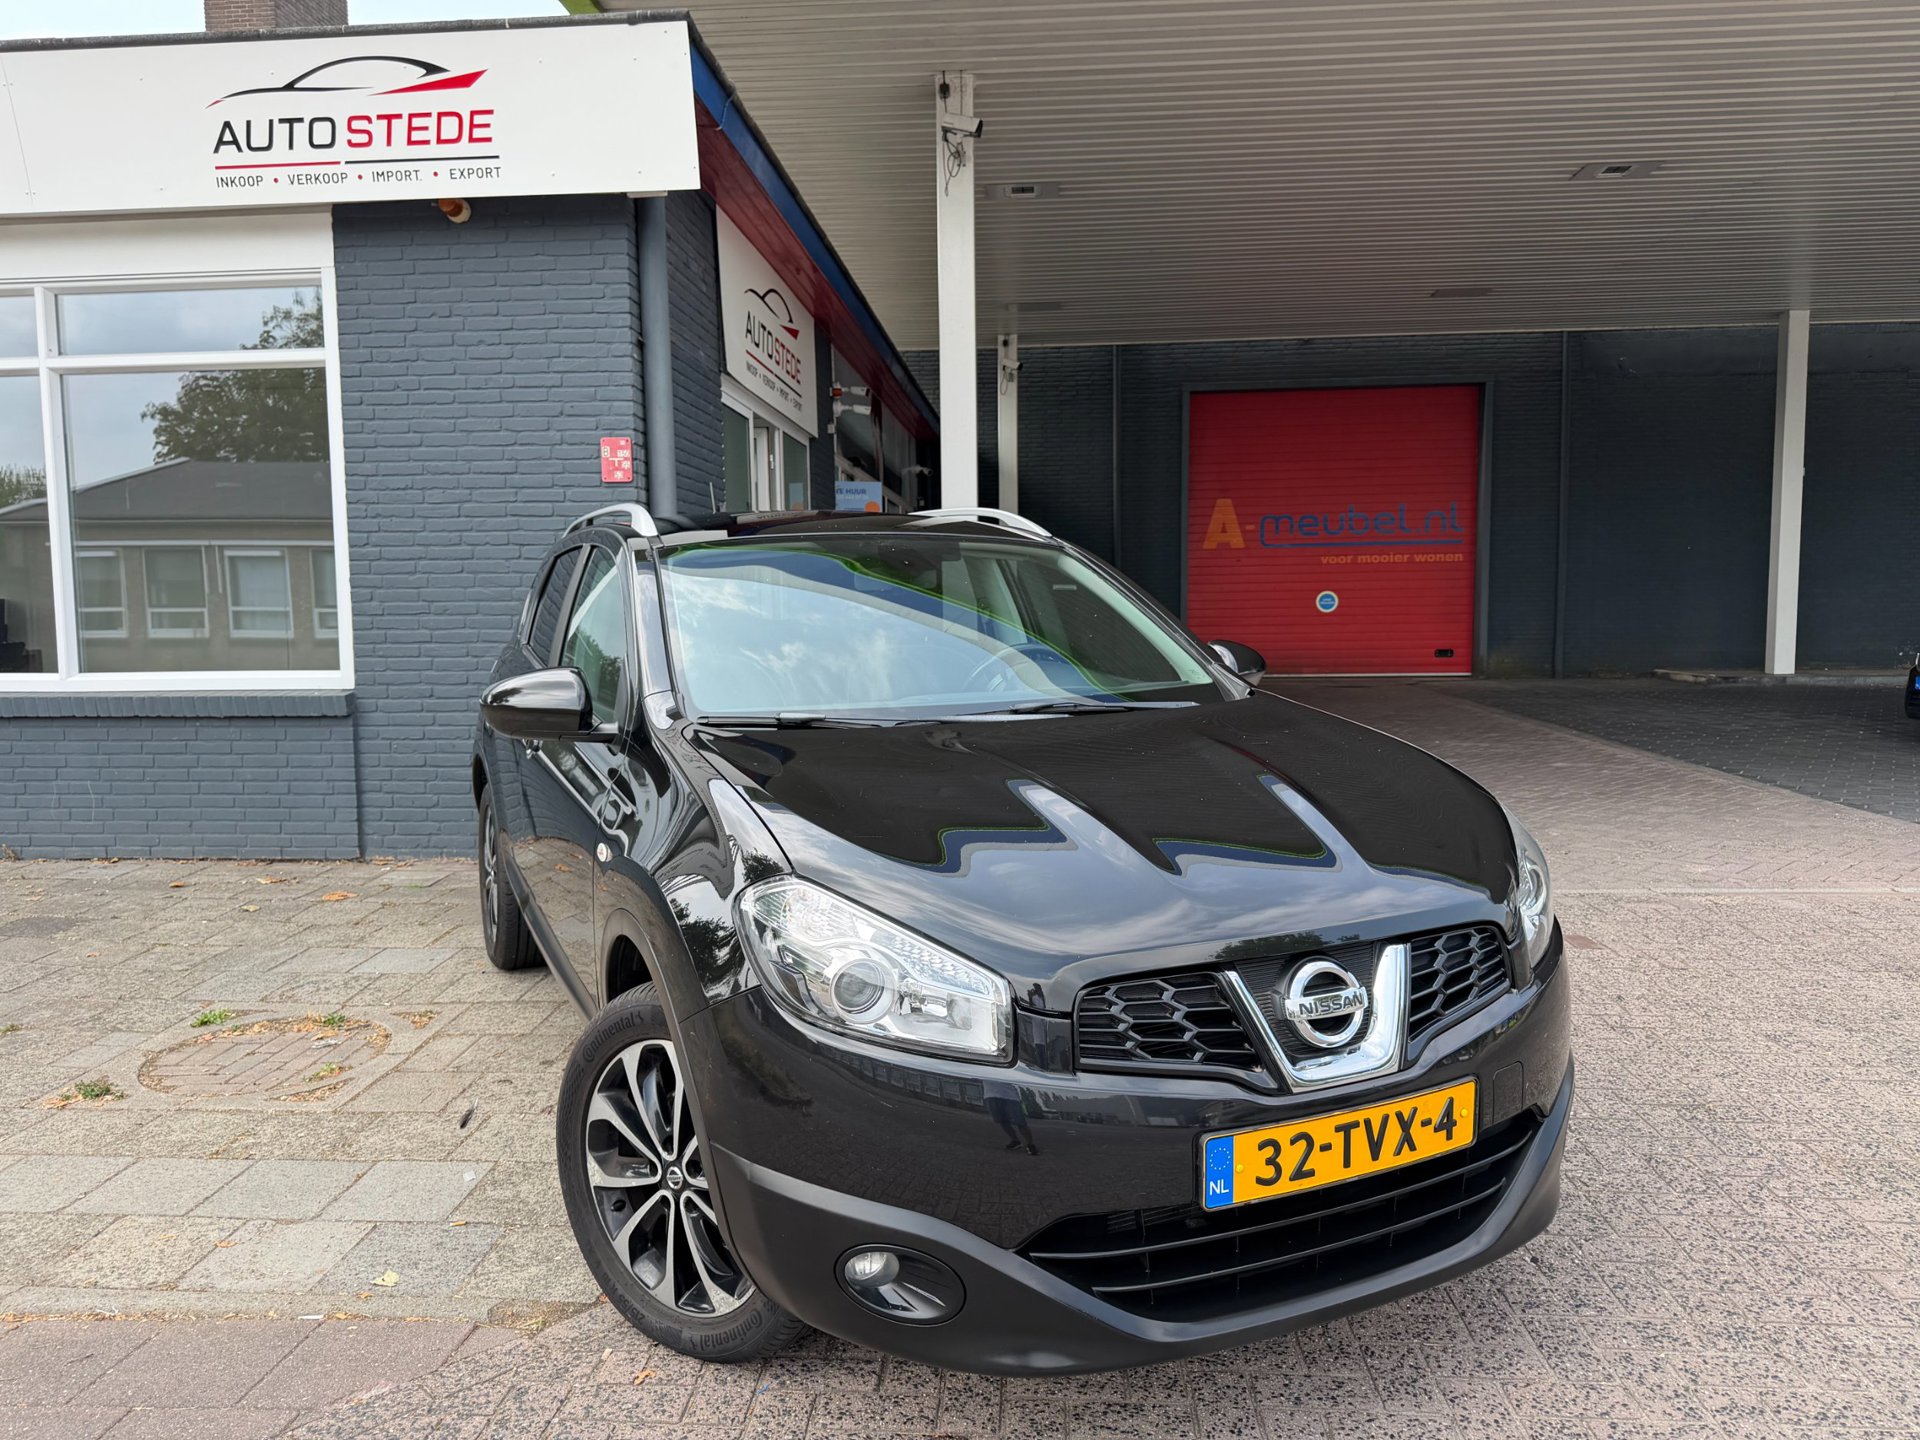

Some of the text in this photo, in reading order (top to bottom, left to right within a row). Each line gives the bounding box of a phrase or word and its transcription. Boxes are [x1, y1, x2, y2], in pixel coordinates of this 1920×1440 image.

[216, 175, 264, 188] INKOOP
[287, 172, 348, 186] VERKOOP
[449, 166, 502, 180] EXPORT
[845, 487, 867, 496] HUUR
[1320, 552, 1464, 565] voor mooier wonen
[1299, 991, 1363, 1015] NISSAN
[583, 1012, 636, 1062] Continental
[1255, 1096, 1457, 1187] 32-TVX-4
[1209, 1179, 1230, 1196] NL
[700, 1308, 762, 1352] Continental
